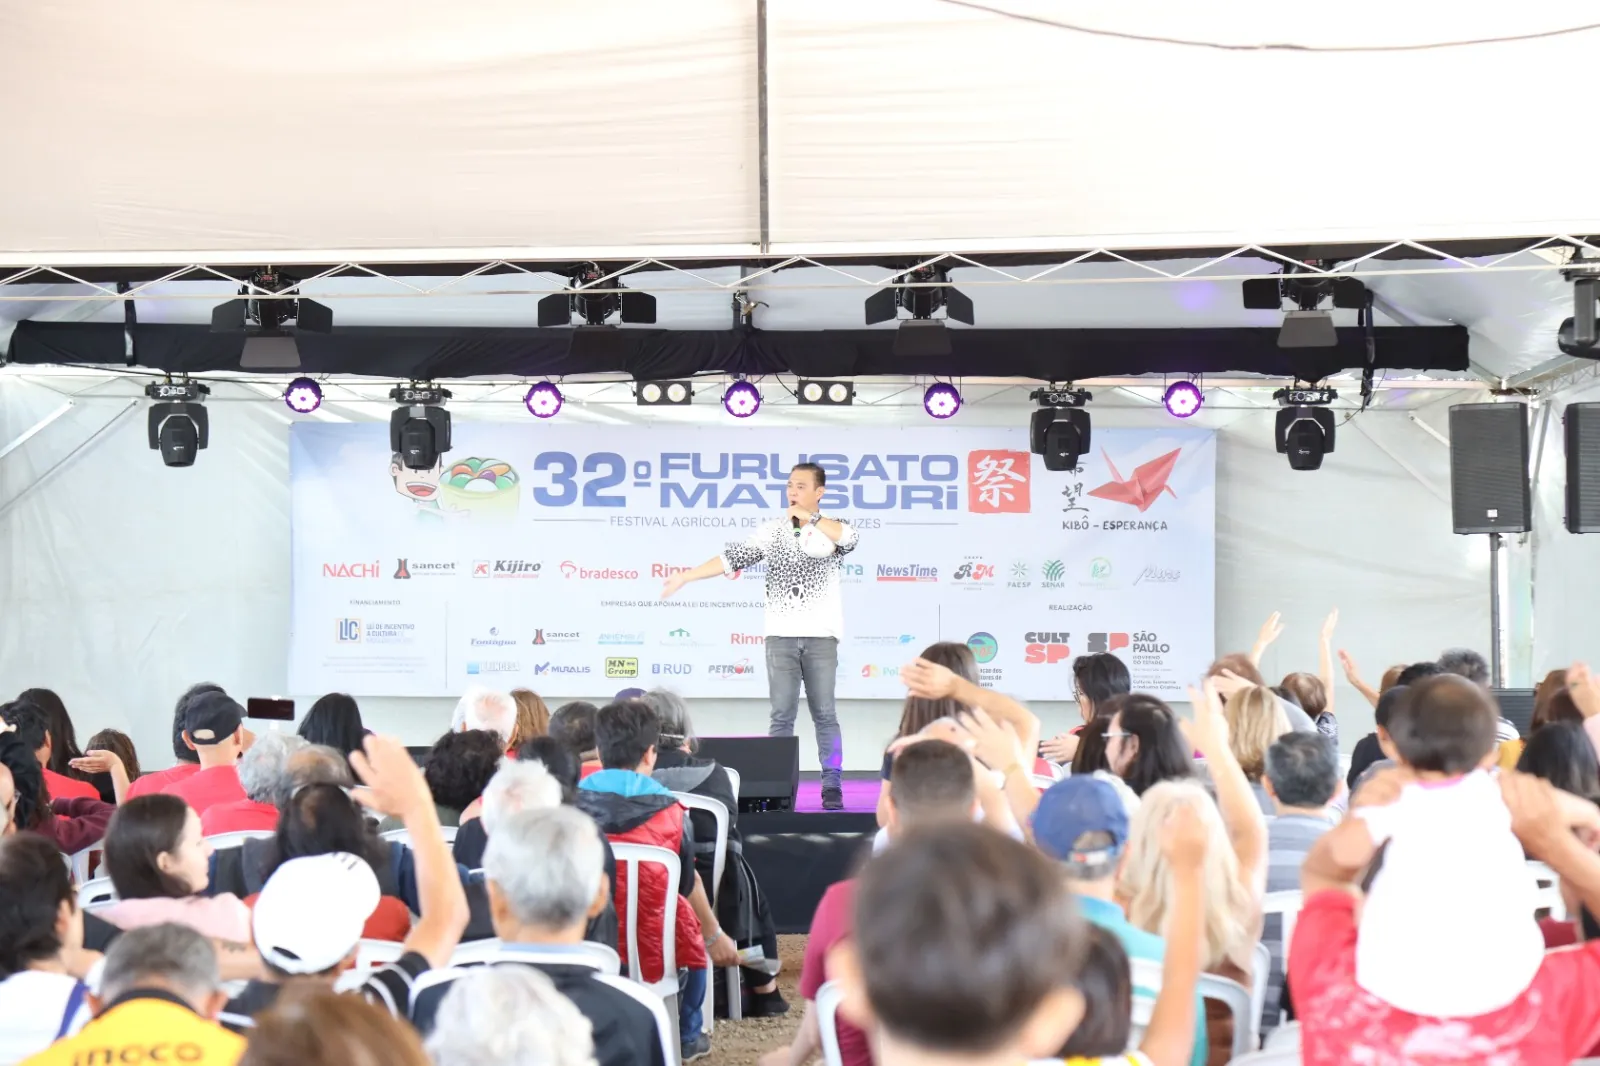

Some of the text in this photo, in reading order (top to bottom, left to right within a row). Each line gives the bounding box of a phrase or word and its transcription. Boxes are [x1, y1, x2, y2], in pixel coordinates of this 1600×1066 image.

[660, 452, 958, 482] FURUSATO
[610, 516, 668, 526] FESTIVAL
[671, 515, 737, 528] AGRÍCOLA
[741, 517, 756, 527] DE
[1062, 515, 1090, 530] KIBÔ
[1102, 520, 1168, 532] ESPERANÇA
[412, 562, 456, 572] sancet
[494, 560, 541, 574] Kijiro
[580, 567, 639, 580] bradesco
[877, 563, 938, 577] NewsTime
[1048, 602, 1093, 612] REALIZAÇÃO
[339, 618, 359, 641] LIC
[1132, 630, 1157, 642] SÃO
[1024, 631, 1070, 644] CULT
[1087, 632, 1130, 652] SP
[1024, 643, 1070, 664] SP
[1132, 643, 1170, 653] PAULO
[551, 665, 591, 673] MURALIS
[608, 660, 626, 668] MN
[663, 664, 693, 674] RUD
[607, 668, 636, 677] Group
